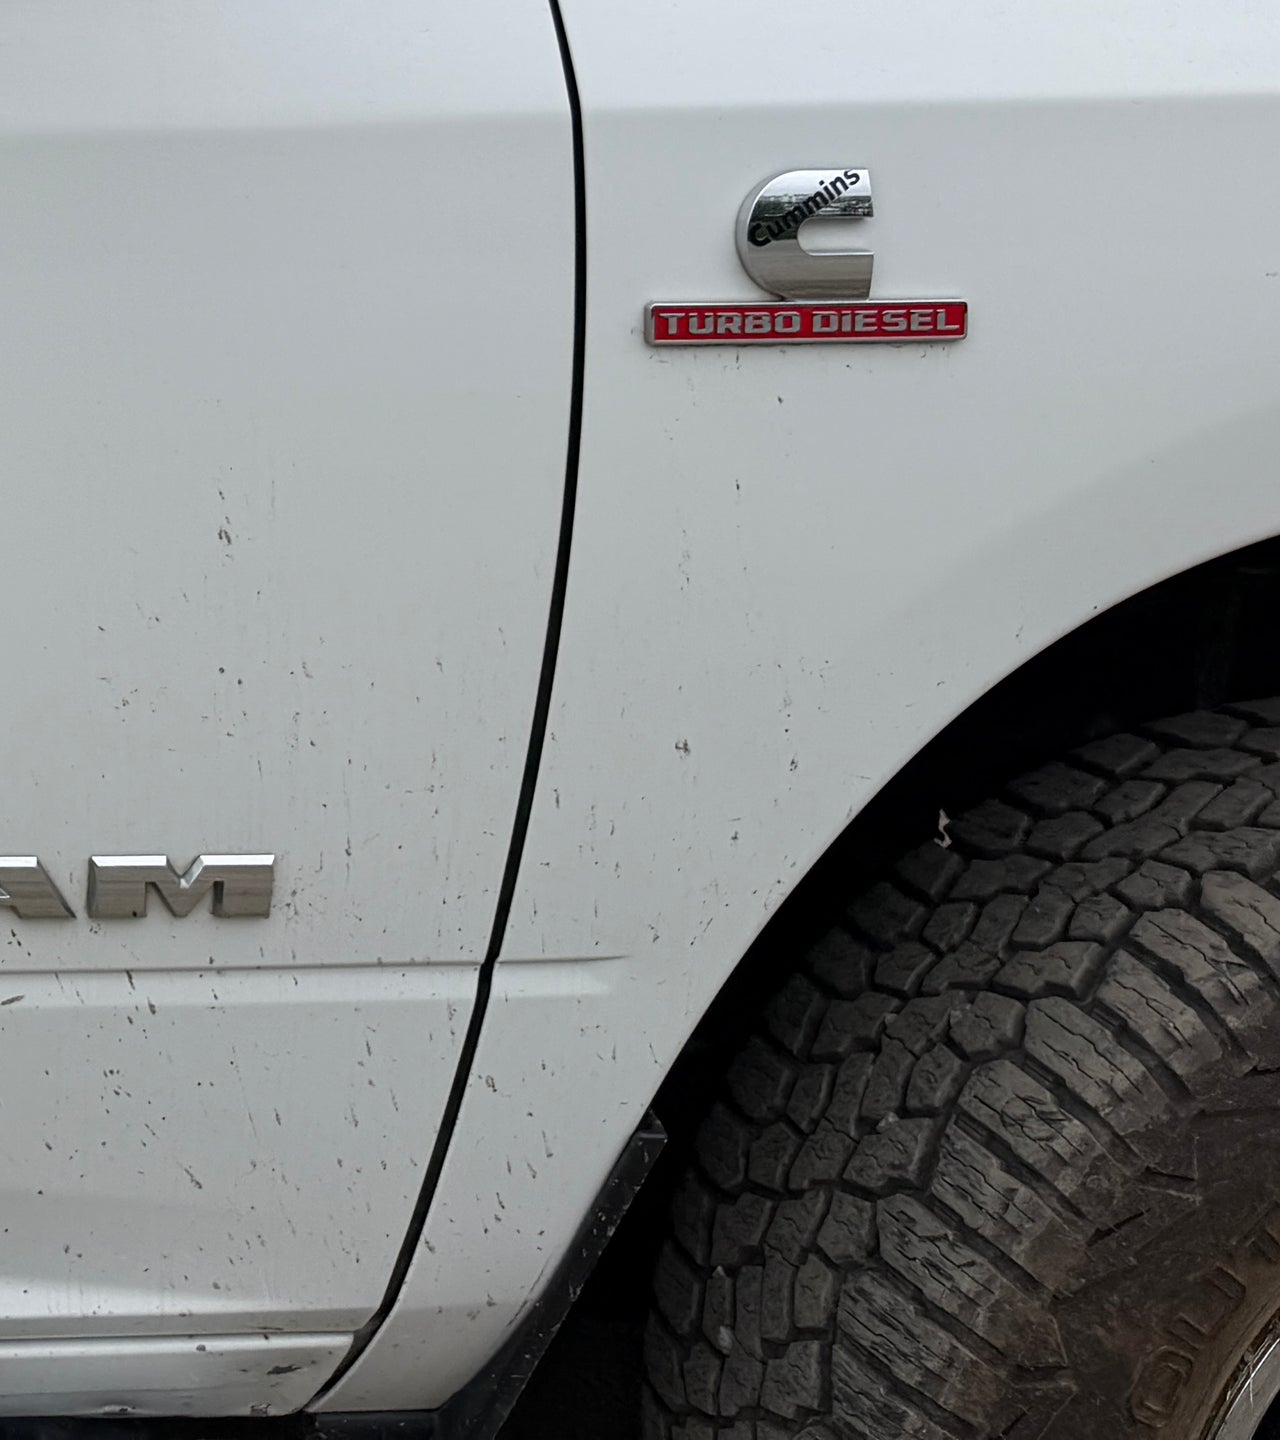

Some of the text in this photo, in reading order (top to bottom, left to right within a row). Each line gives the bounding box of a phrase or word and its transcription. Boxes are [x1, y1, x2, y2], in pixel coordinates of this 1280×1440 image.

[747, 169, 861, 248] Cummins
[659, 308, 961, 336] TURBO DIESEL
